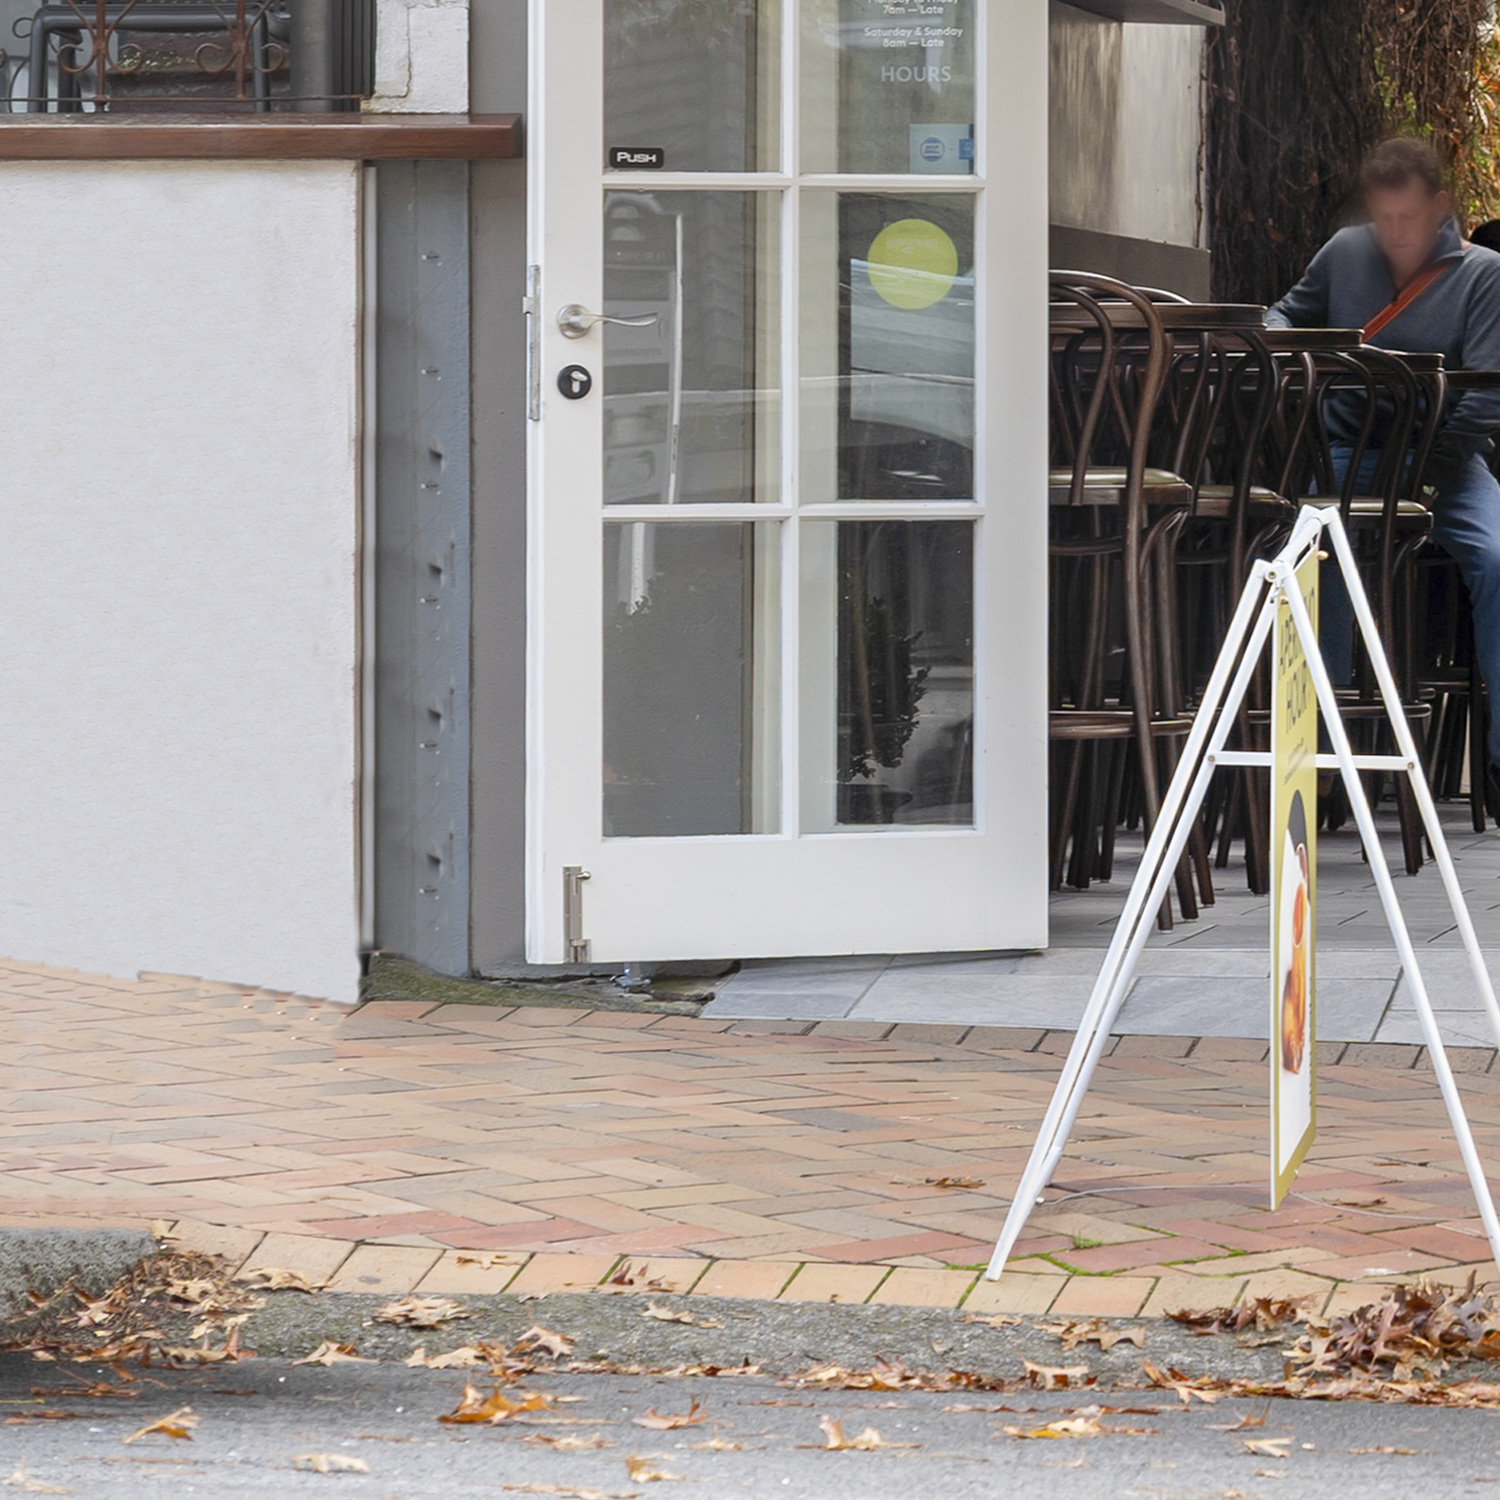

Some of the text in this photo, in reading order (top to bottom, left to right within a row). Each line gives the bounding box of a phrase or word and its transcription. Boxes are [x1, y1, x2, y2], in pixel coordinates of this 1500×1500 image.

[883, 5, 905, 14] 7am
[921, 5, 944, 14] Late
[864, 27, 913, 38] Saturday
[924, 27, 963, 38] Sunday
[921, 38, 944, 47] Late
[881, 66, 952, 82] HOURS
